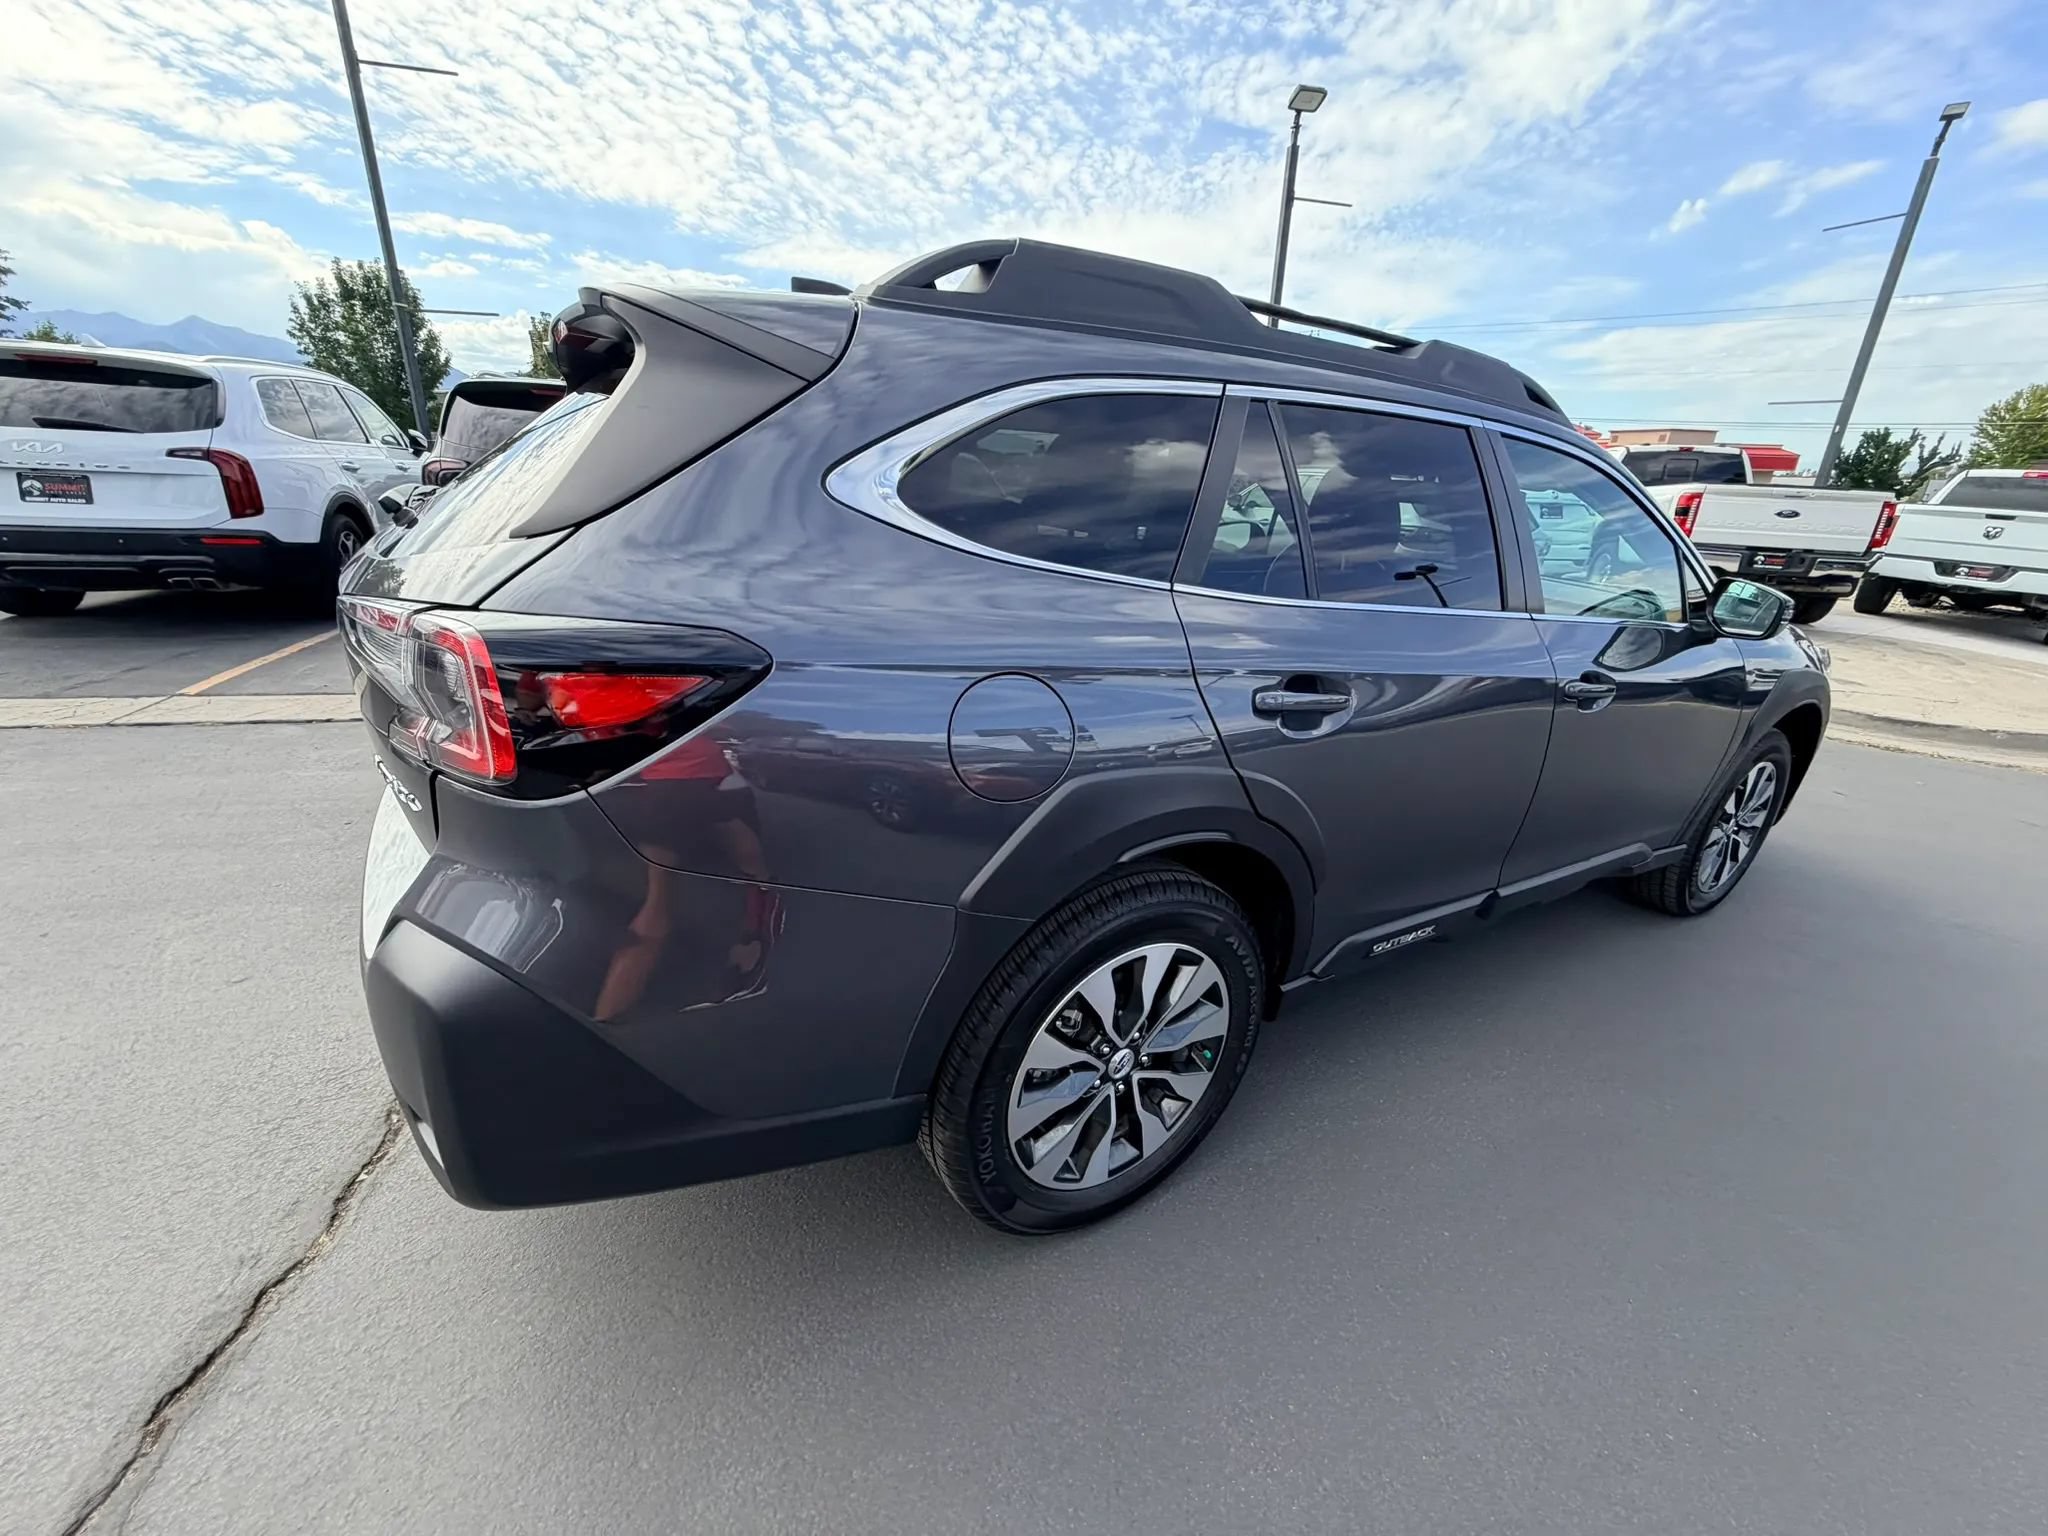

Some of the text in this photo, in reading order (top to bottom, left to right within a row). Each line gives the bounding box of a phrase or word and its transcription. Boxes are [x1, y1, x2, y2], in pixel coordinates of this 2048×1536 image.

[12, 440, 64, 453] KIA
[44, 483, 87, 492] SUMMIT
[1373, 925, 1436, 953] OUTBACK
[977, 1080, 998, 1185] YOKOHAM
